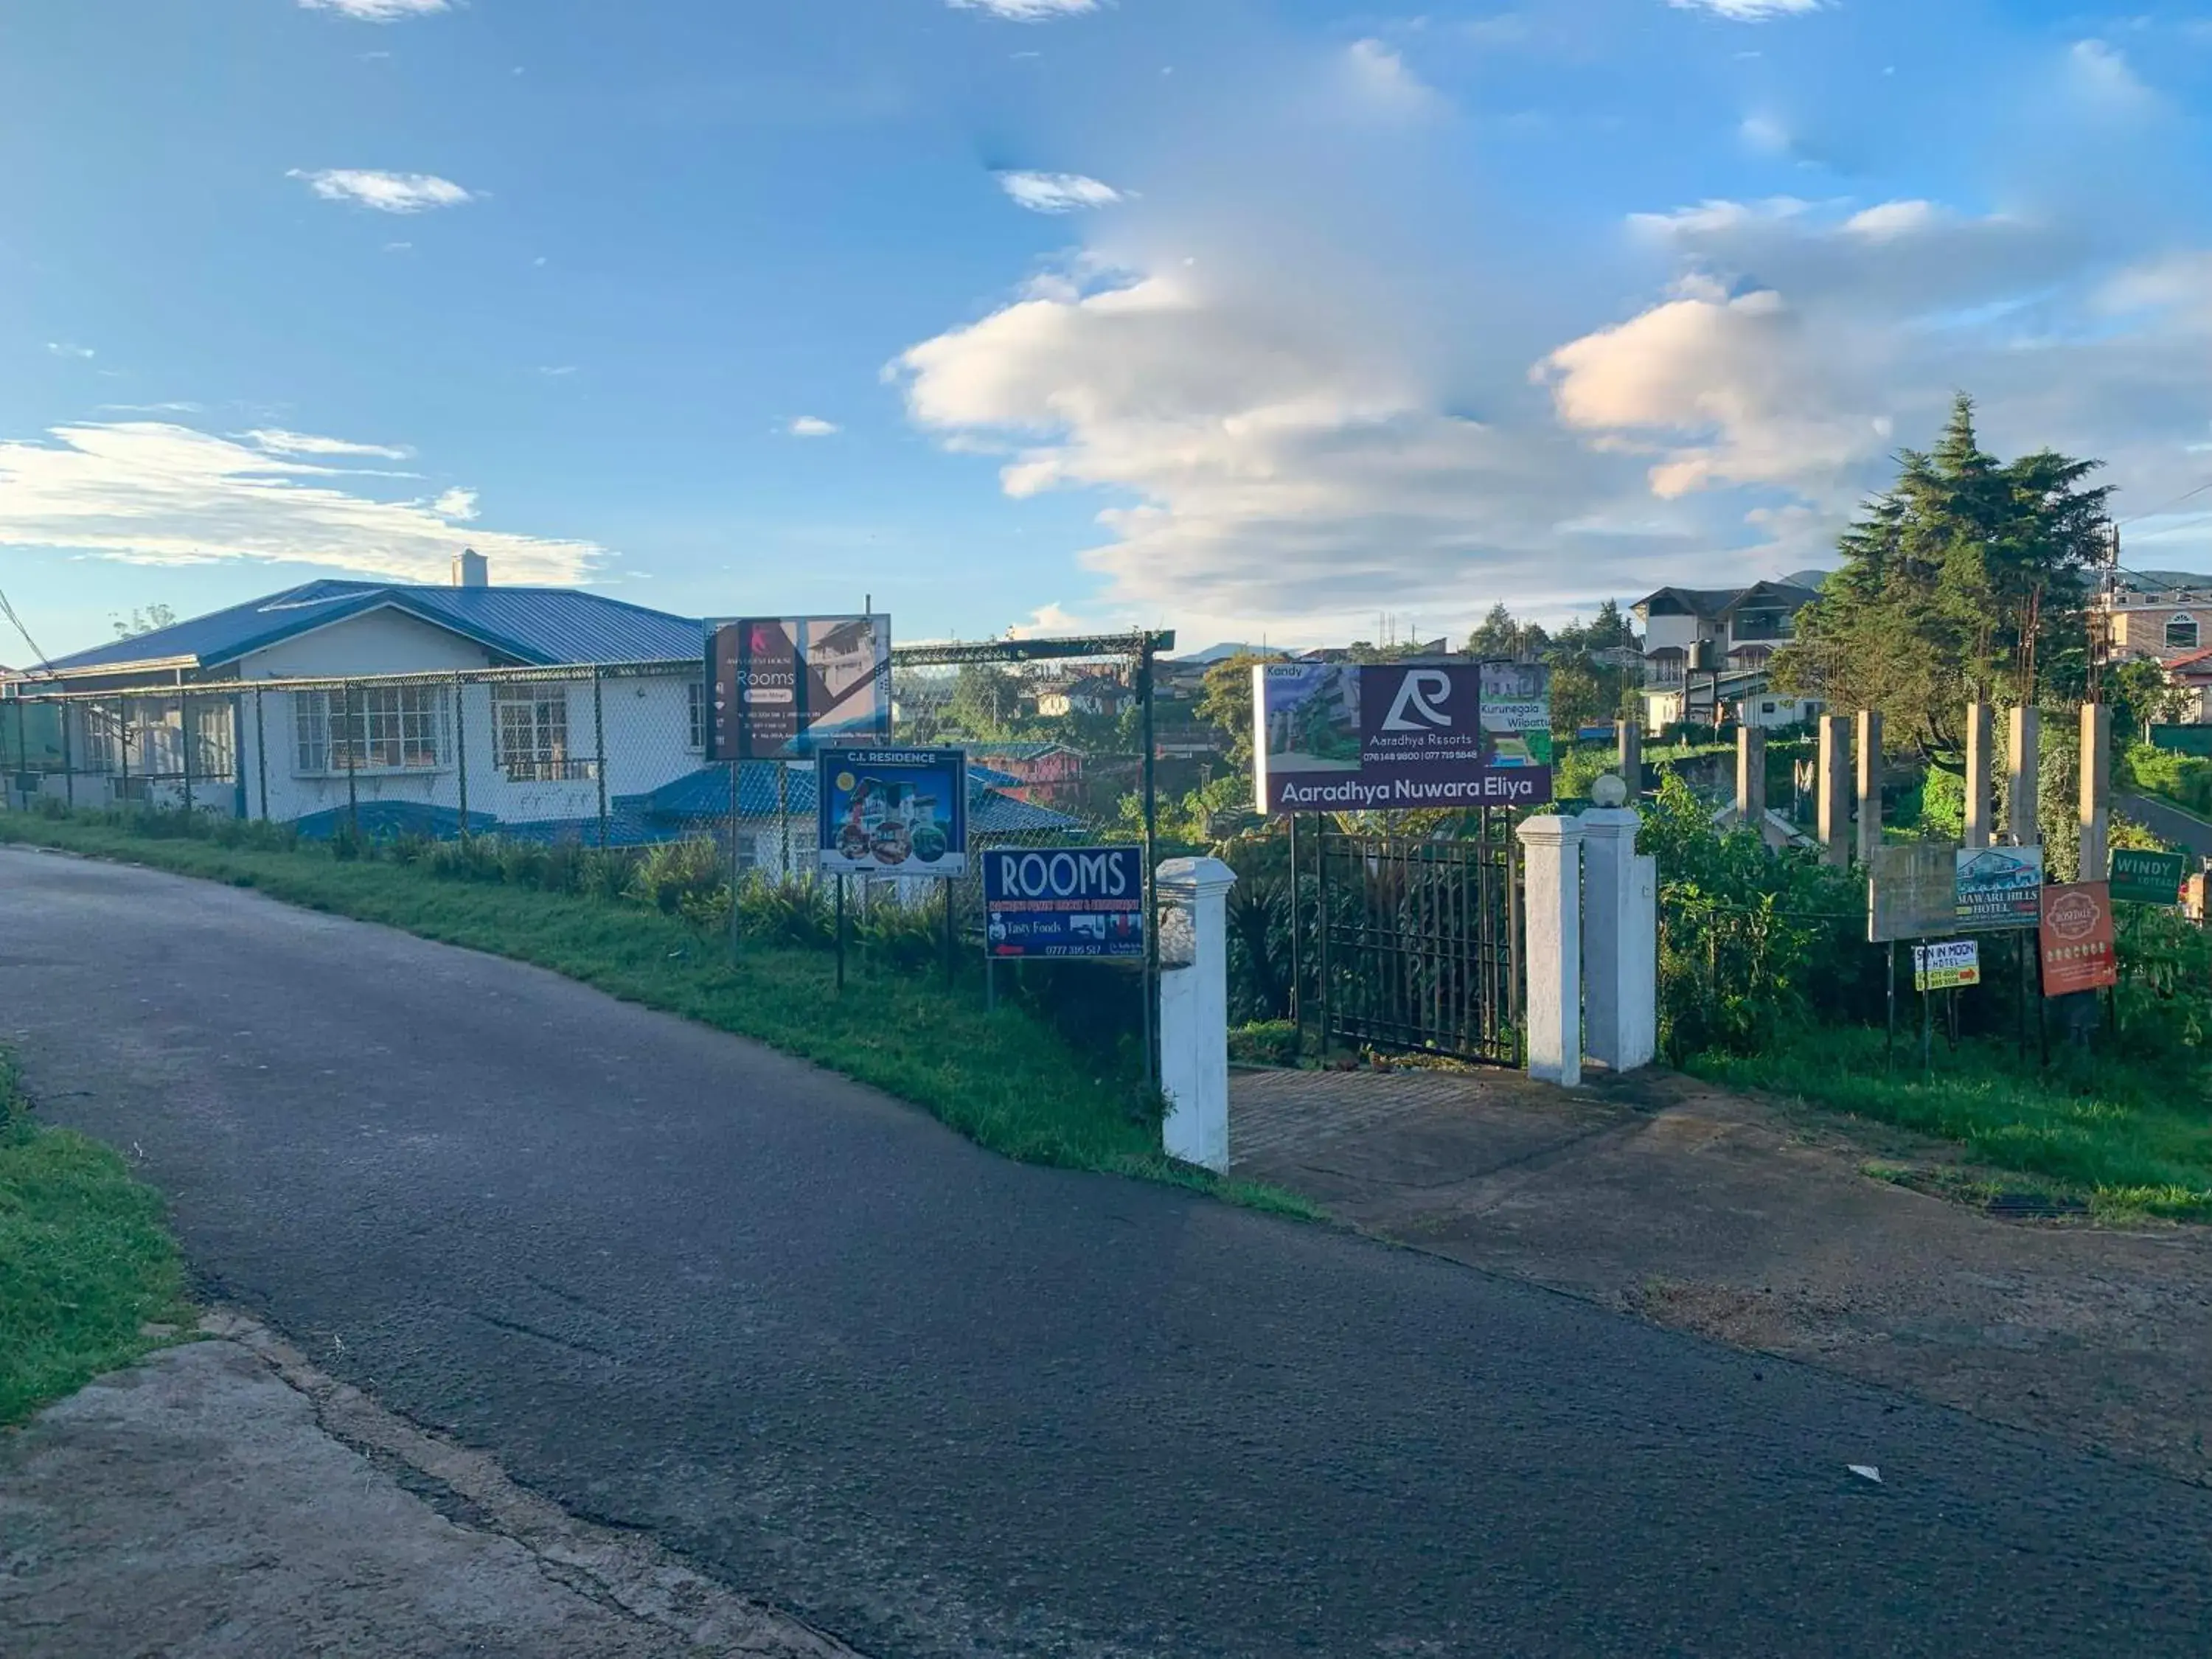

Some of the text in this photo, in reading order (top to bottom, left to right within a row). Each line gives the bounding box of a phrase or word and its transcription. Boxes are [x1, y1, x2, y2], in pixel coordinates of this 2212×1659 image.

[737, 670, 794, 686] Rooms
[1267, 665, 1302, 678] Kandy
[1481, 704, 1540, 717] Kurunegala
[1370, 734, 1472, 748] Aaradhya Resorts
[869, 753, 936, 764] RESIDENCE
[1281, 776, 1532, 806] Aaradhya Nuwara Eliya
[2117, 858, 2171, 875] WINDY
[1001, 852, 1126, 897] ROOMS
[2008, 890, 2037, 901] HILLS
[1973, 903, 2011, 914] HOTEL
[1007, 922, 1061, 936] Tasty Foods
[1917, 948, 1934, 960] SN
[1949, 943, 1974, 956] MOON
[1933, 958, 1958, 967] HOTEL
